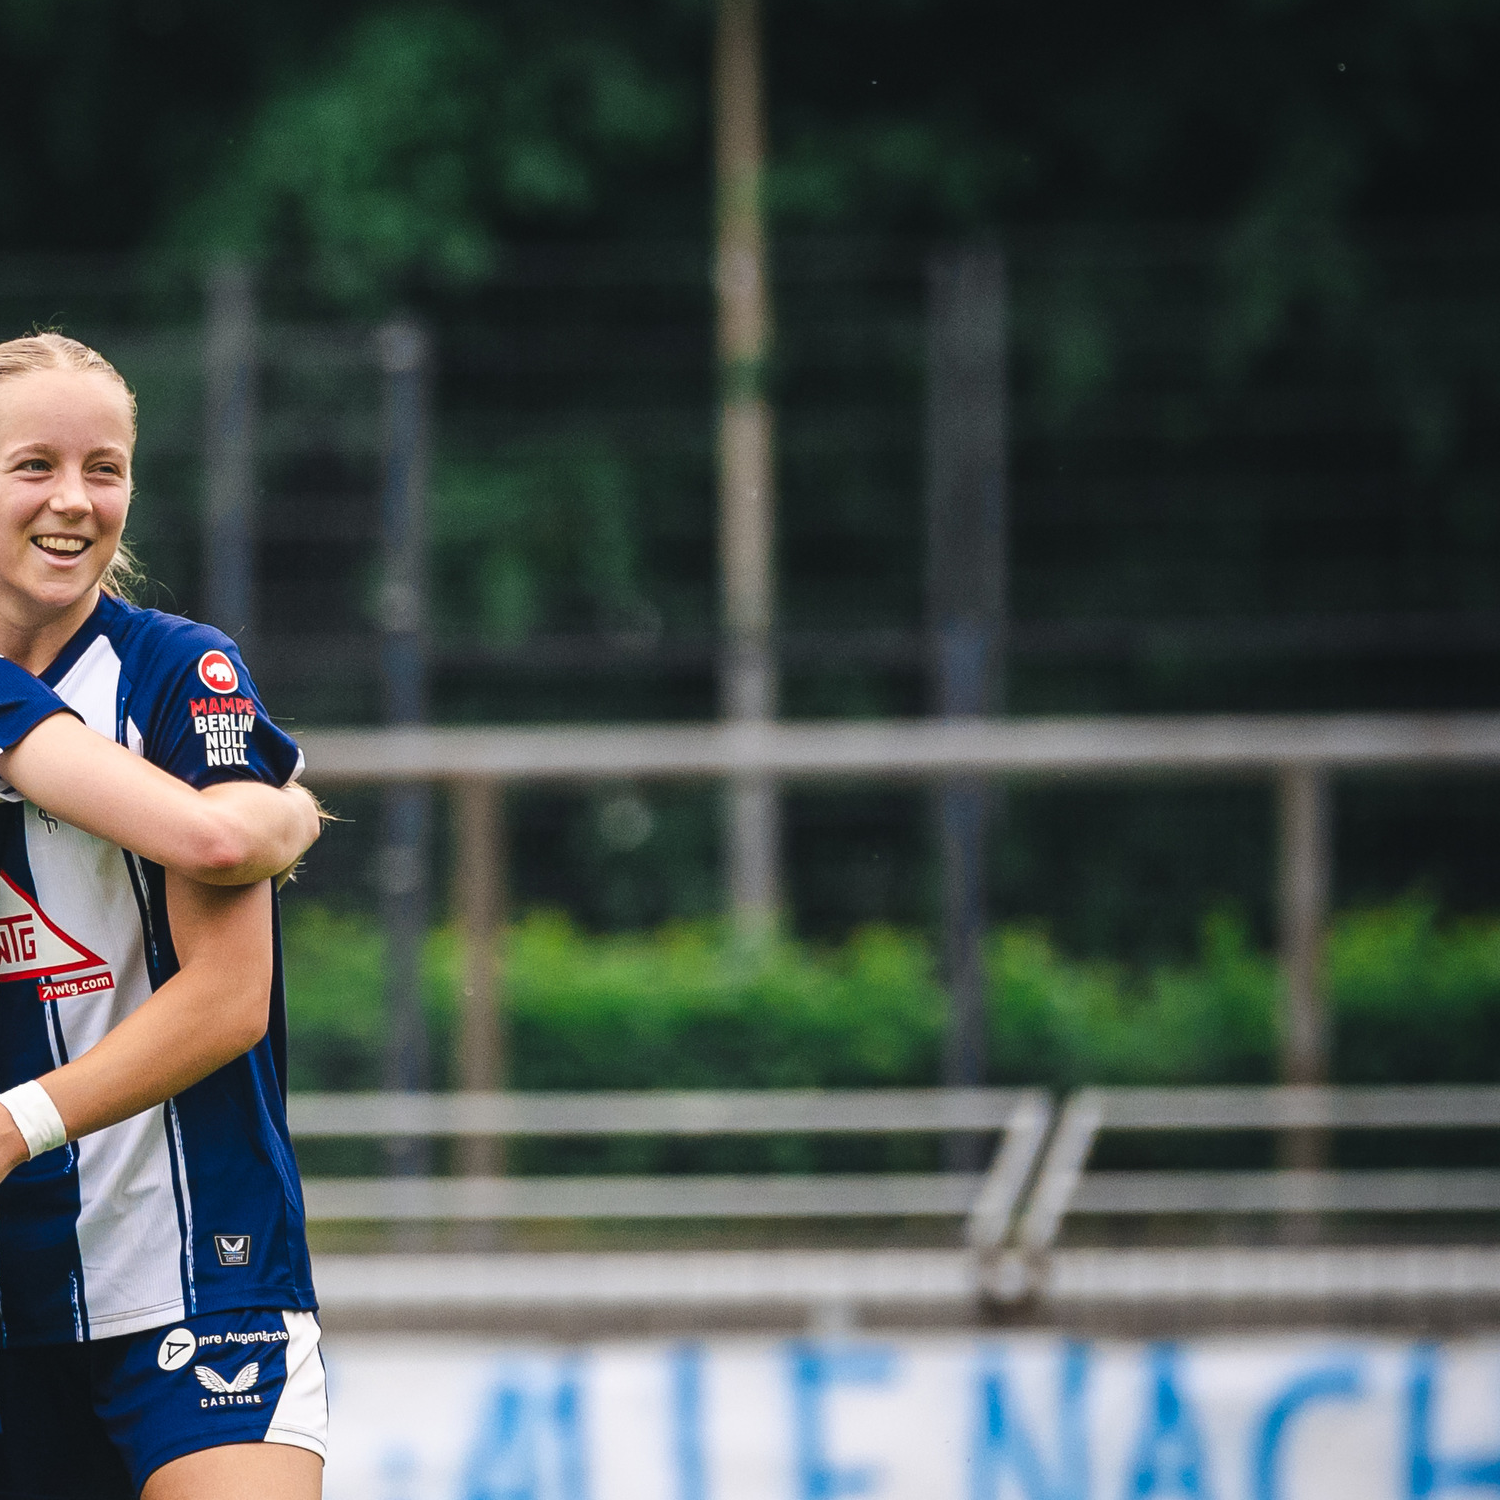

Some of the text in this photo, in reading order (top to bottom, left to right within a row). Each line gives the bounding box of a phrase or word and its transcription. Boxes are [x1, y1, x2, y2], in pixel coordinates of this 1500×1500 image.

[189, 697, 257, 717] MAMPE
[194, 714, 256, 735] BERLIN
[205, 731, 248, 749] NULL
[206, 748, 250, 767] NULL
[52, 976, 111, 996] wtg.com
[199, 1330, 289, 1347] Ihre Augenärzte
[200, 1394, 263, 1408] CASTORE
